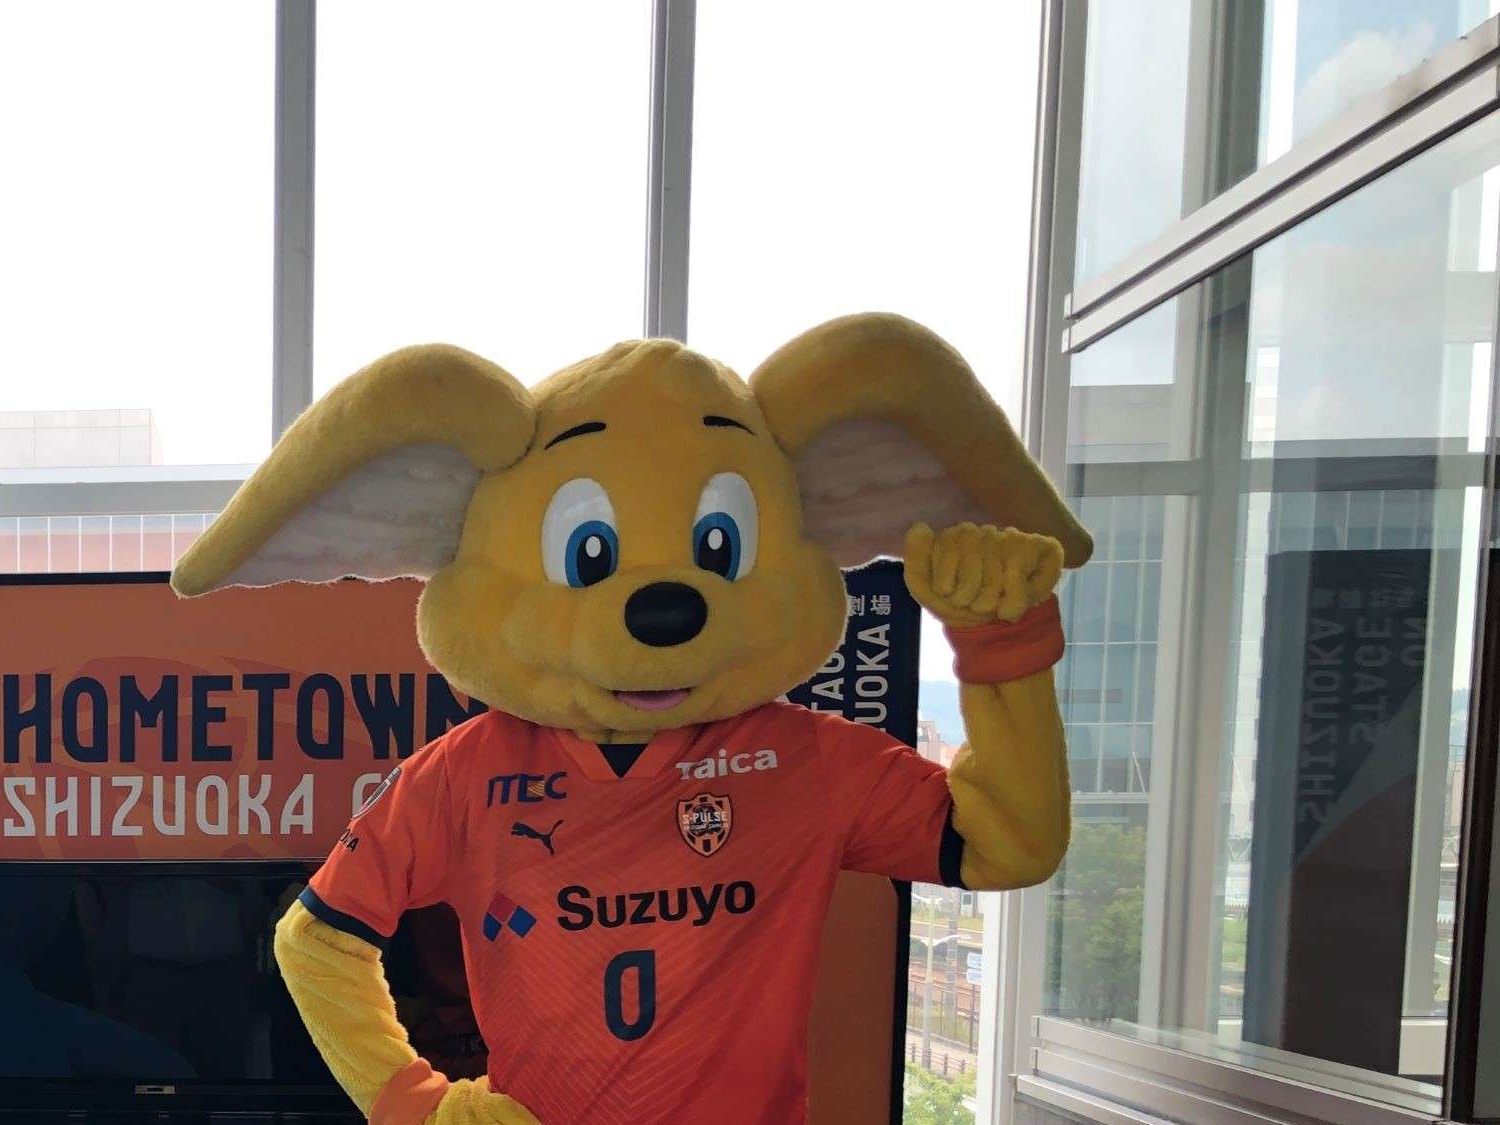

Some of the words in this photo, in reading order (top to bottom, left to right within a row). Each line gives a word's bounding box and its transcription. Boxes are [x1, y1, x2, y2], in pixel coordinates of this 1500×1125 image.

[854, 623, 890, 731] UOKA
[676, 748, 779, 780] Taica
[3, 774, 314, 837] SHIZUOKA
[557, 880, 756, 931] Suzuyo
[604, 950, 656, 1041] 0
